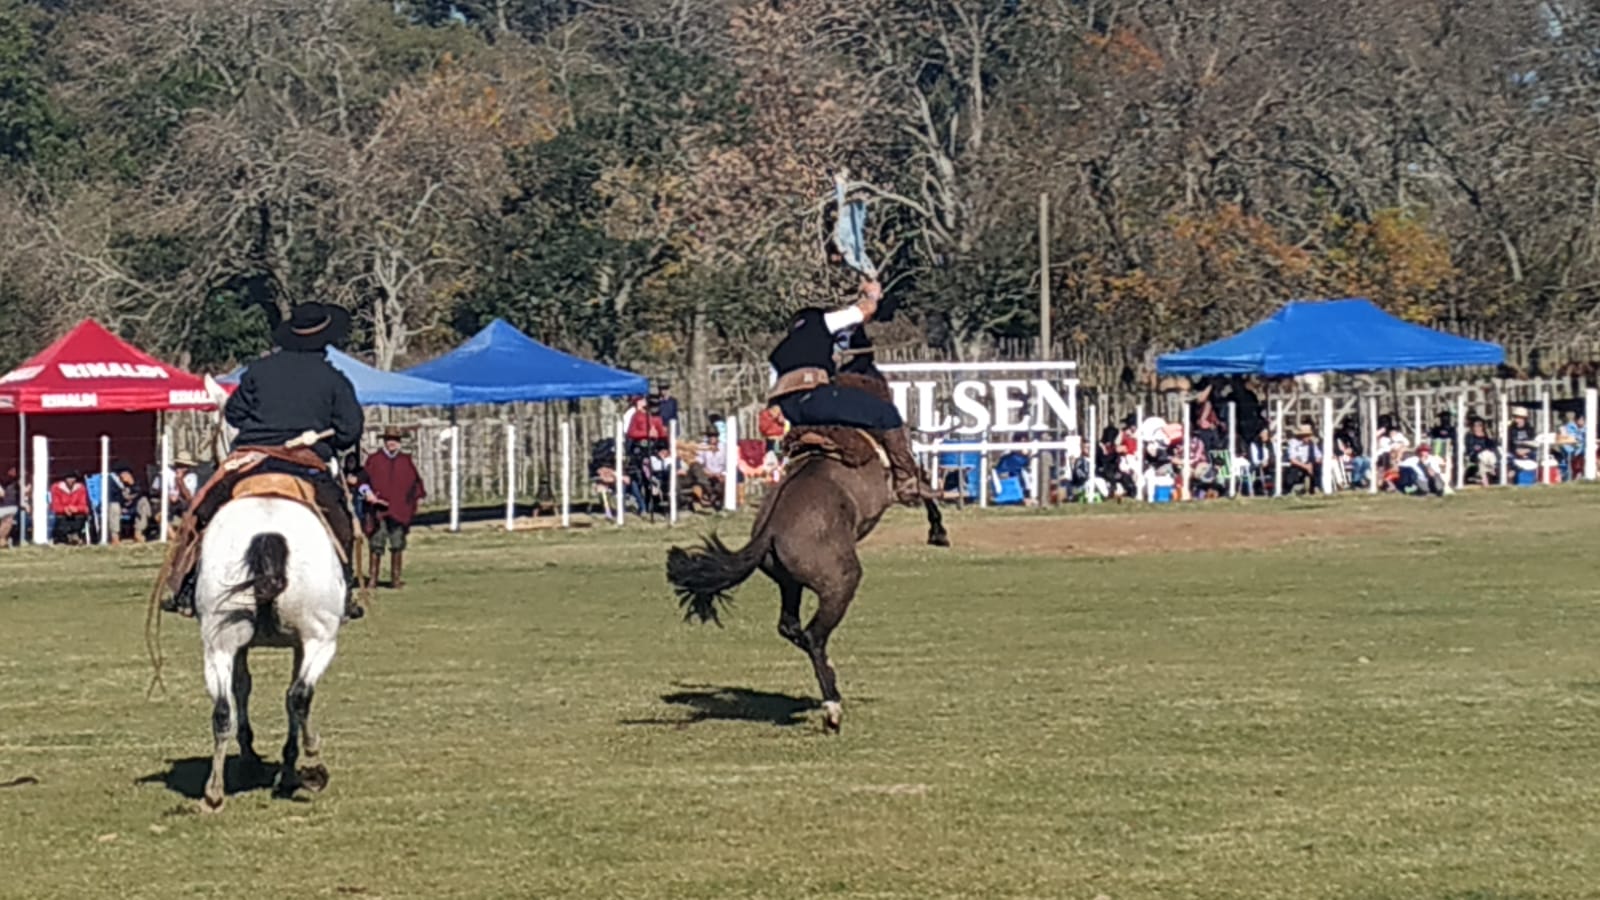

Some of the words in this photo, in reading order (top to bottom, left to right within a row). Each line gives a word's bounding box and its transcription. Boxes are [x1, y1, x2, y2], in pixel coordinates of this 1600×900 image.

[58, 362, 169, 379] RINALDI
[41, 393, 98, 408] RINALDI
[887, 378, 1080, 434] ILSEN
